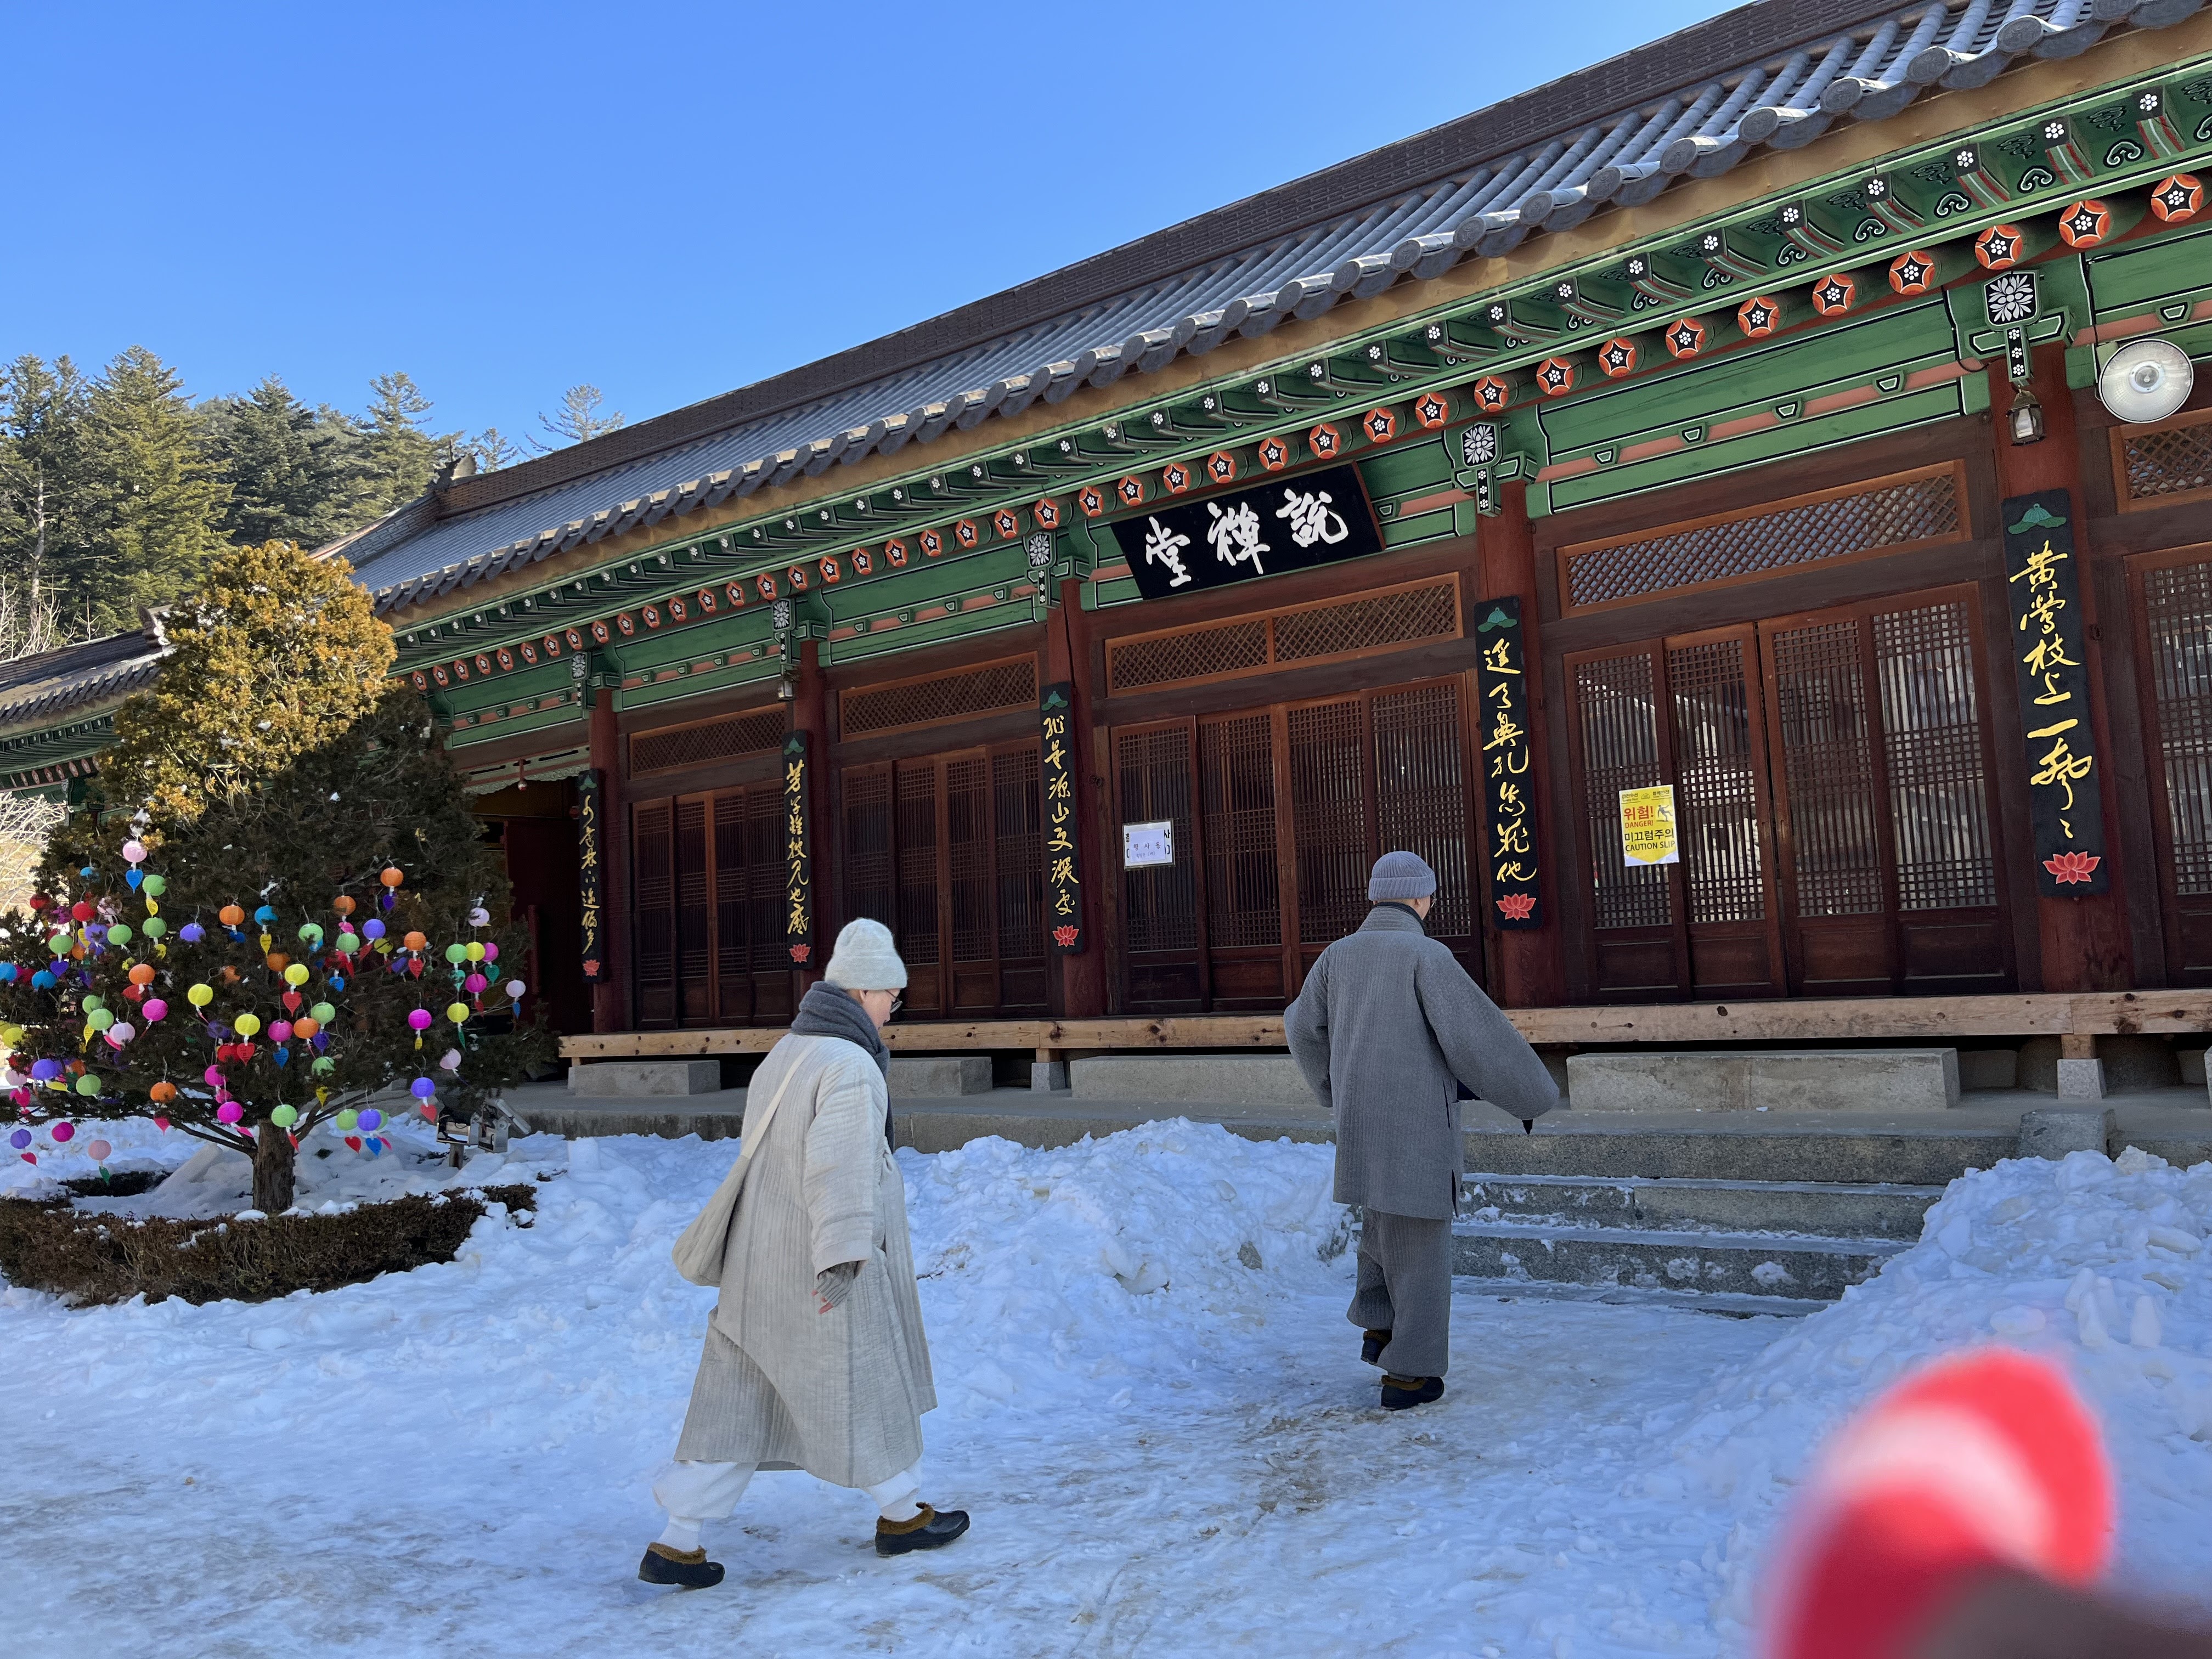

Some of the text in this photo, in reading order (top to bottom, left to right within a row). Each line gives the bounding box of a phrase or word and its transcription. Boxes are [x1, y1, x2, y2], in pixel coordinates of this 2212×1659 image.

[1624, 805, 1654, 821] 위험!
[1625, 820, 1654, 828] DANGER!
[1624, 828, 1674, 842] 미끄럼주의
[1625, 840, 1675, 851] CAUTION SLIP
